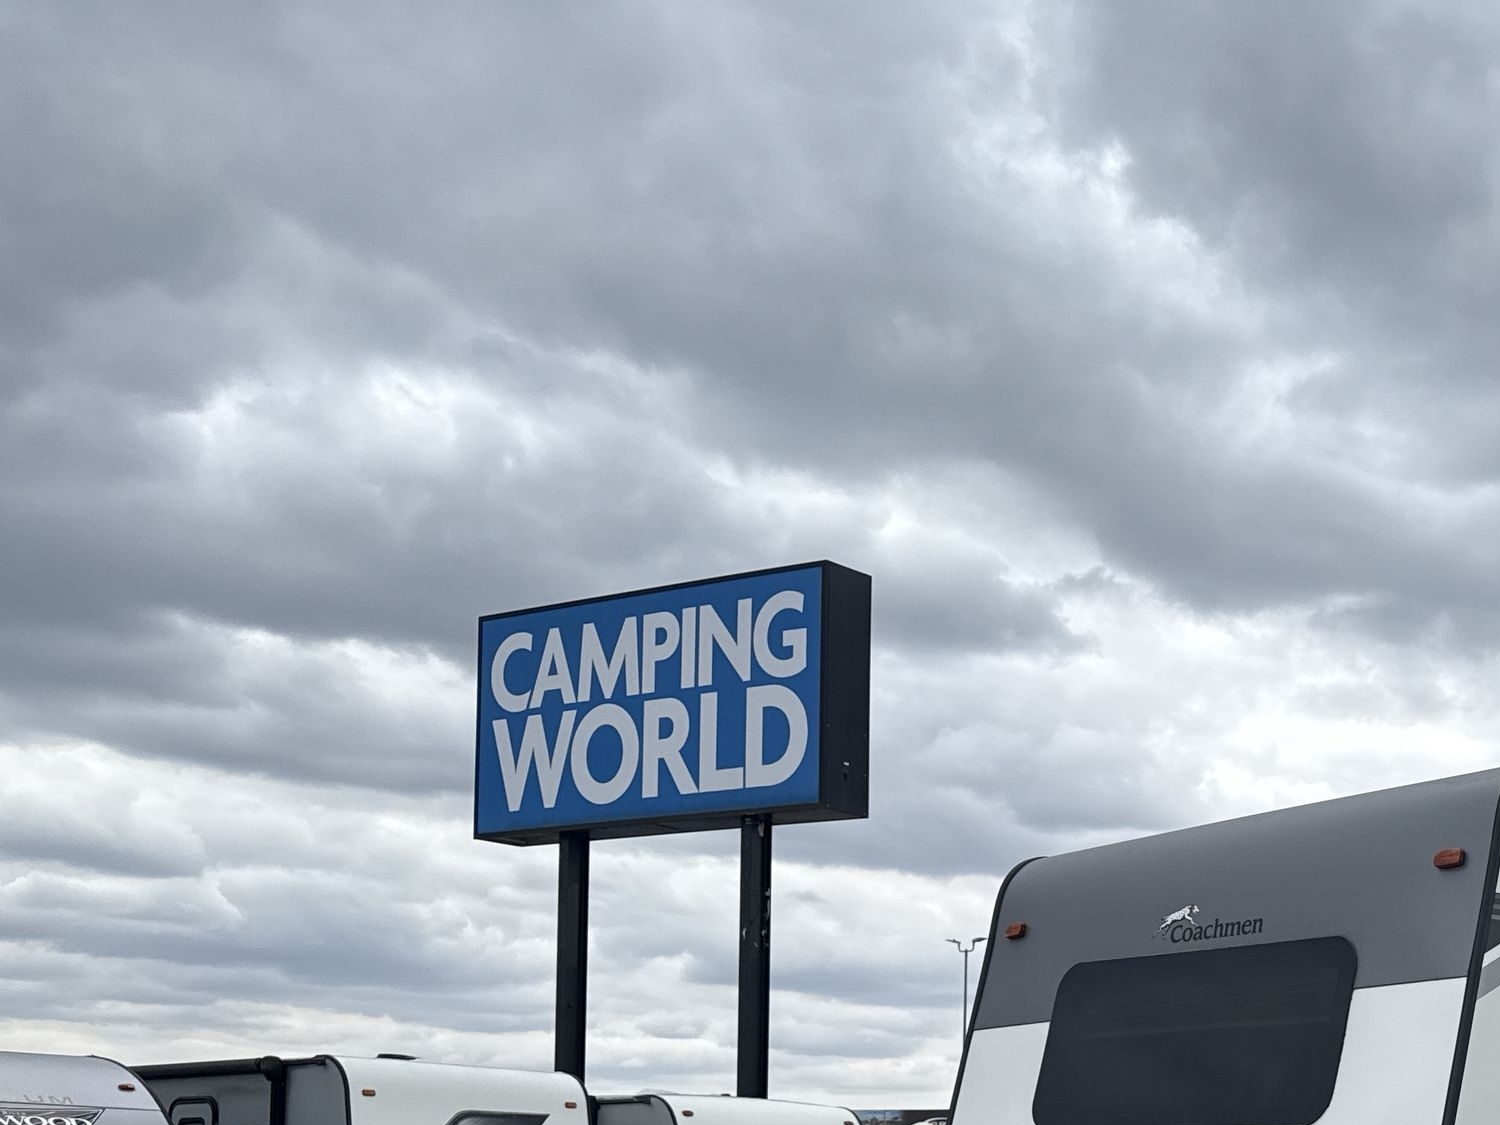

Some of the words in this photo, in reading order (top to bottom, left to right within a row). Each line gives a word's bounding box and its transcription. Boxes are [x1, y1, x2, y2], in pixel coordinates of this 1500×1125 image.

[491, 590, 808, 713] CAMPING
[492, 684, 809, 812] WORLD
[1170, 918, 1264, 943] Coachmen
